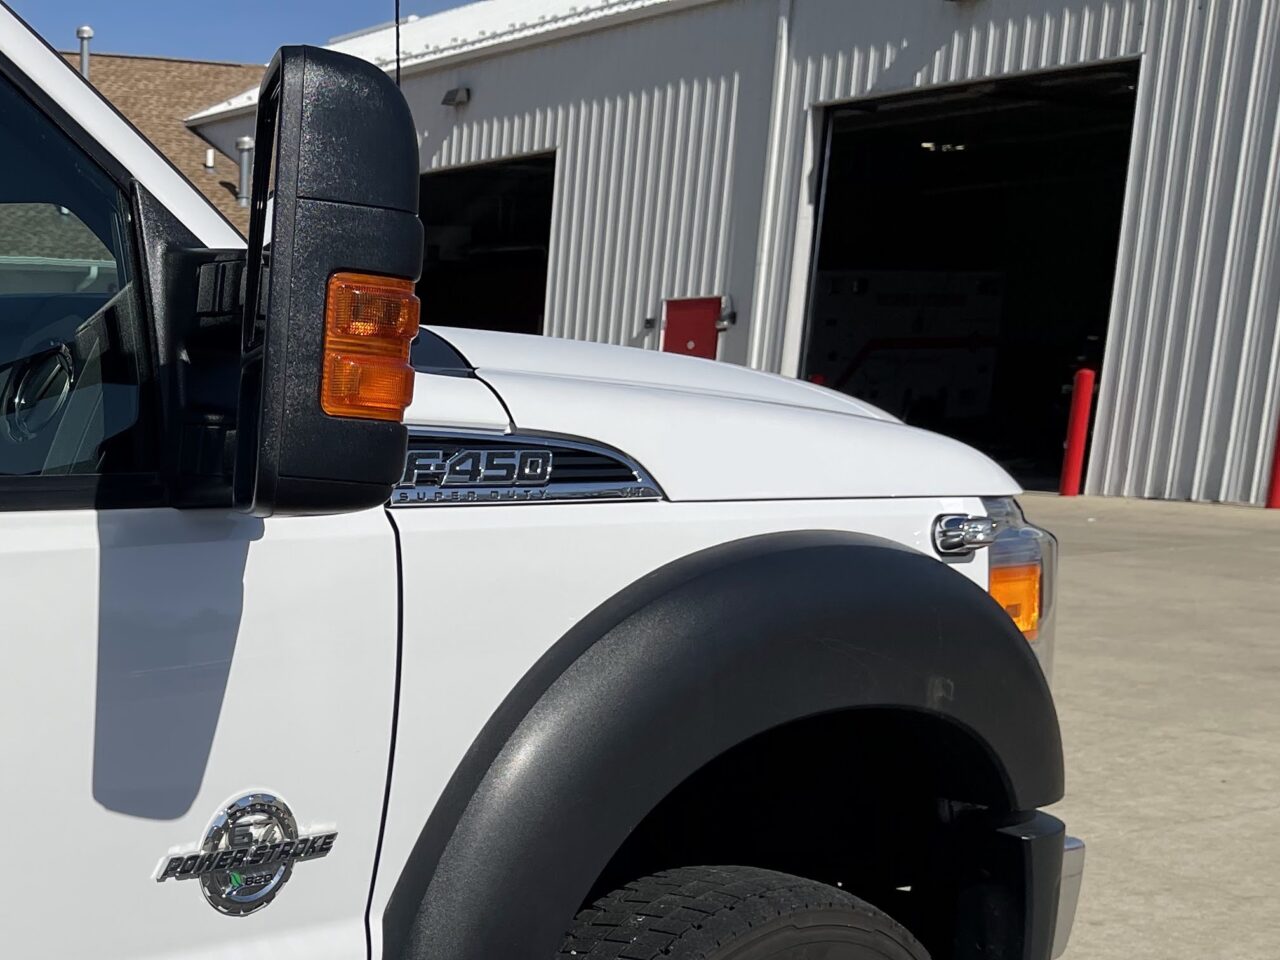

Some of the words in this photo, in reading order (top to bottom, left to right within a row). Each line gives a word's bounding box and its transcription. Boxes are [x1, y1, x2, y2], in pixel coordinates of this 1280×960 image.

[399, 449, 553, 487] F-450
[399, 491, 478, 502] SUPER
[490, 489, 551, 500] DUTY
